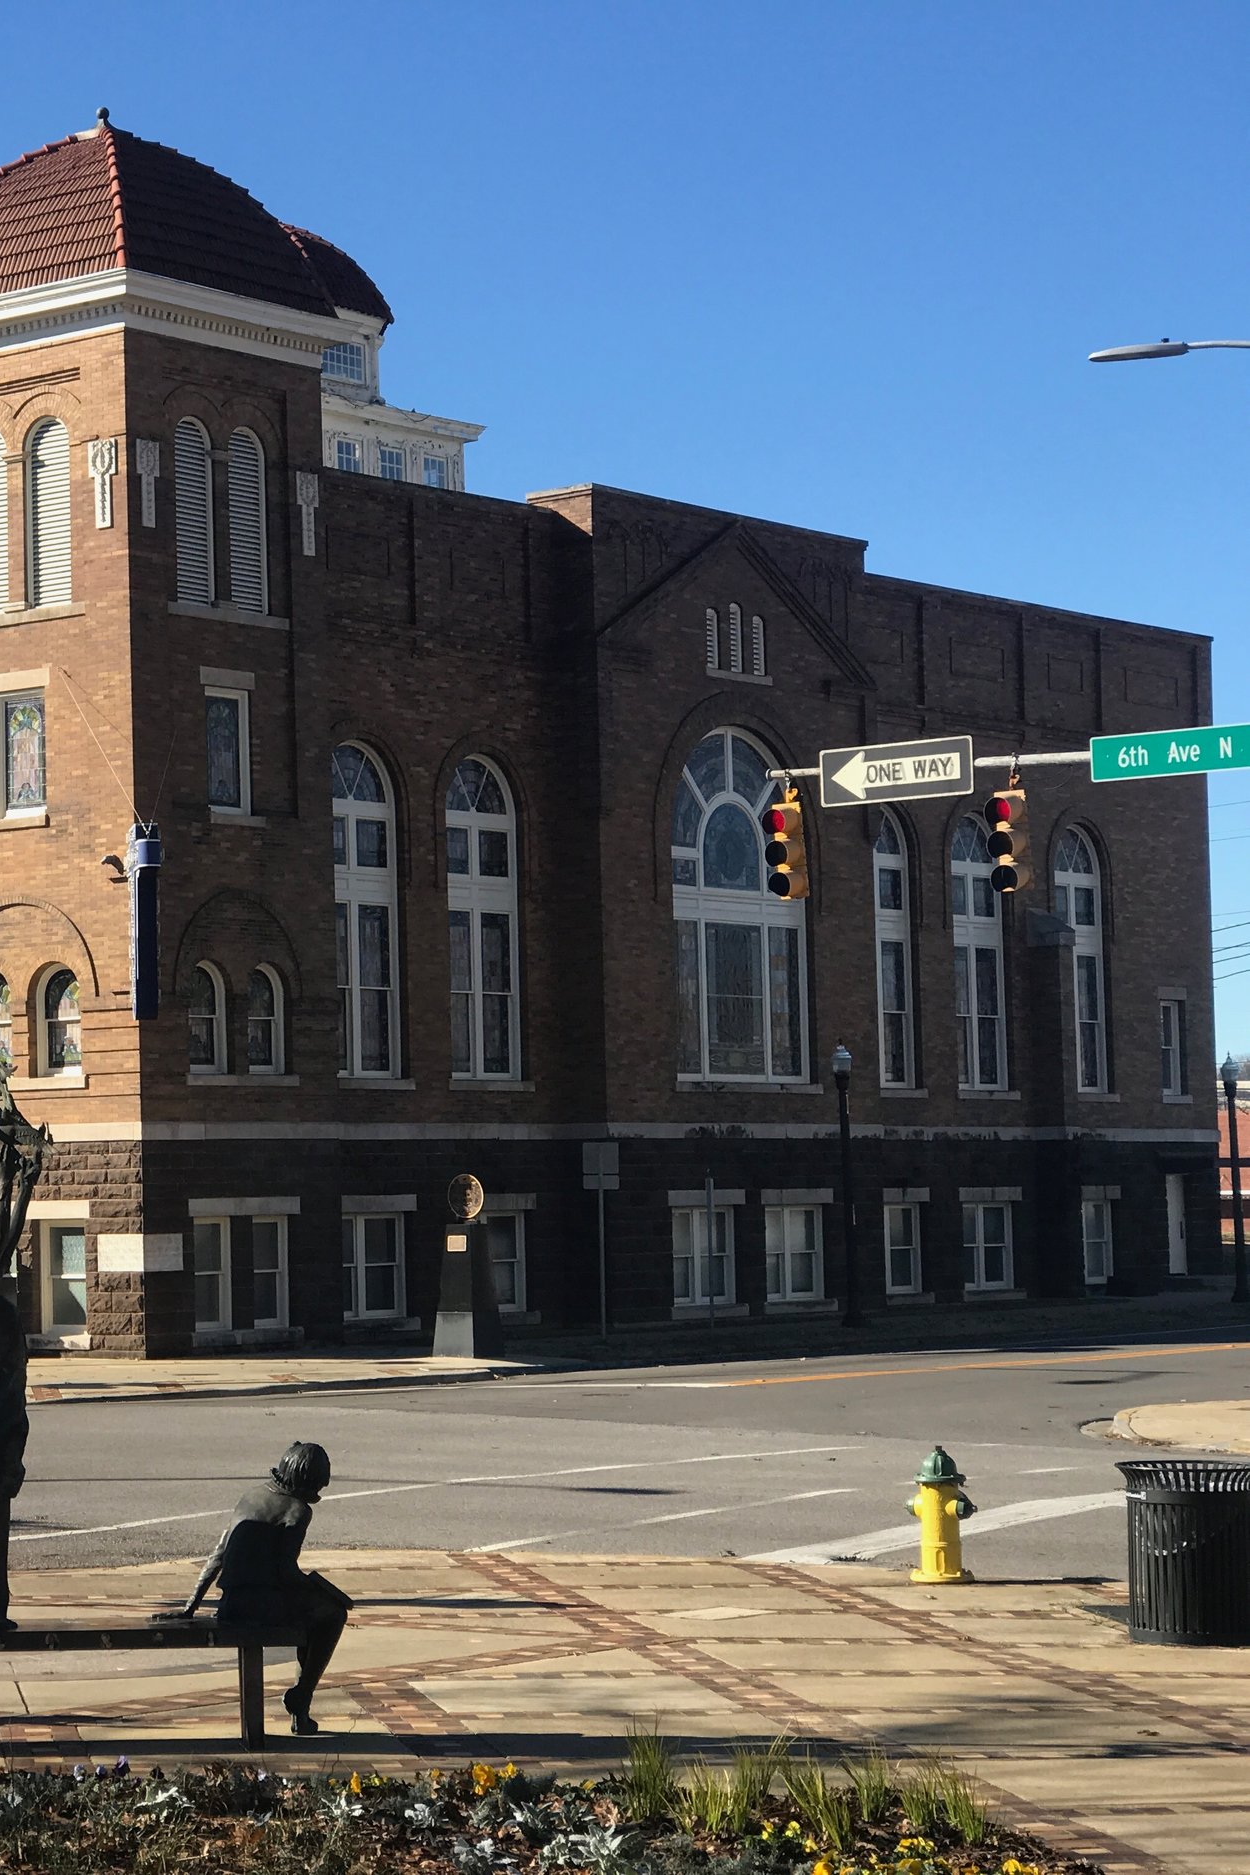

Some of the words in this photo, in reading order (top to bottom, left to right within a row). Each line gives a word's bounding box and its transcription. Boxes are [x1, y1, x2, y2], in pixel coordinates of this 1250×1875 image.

[1117, 744, 1149, 768] 6th
[1167, 741, 1201, 764] Ave
[1219, 736, 1232, 759] N
[866, 761, 903, 784] ONE
[913, 756, 952, 779] WAY
